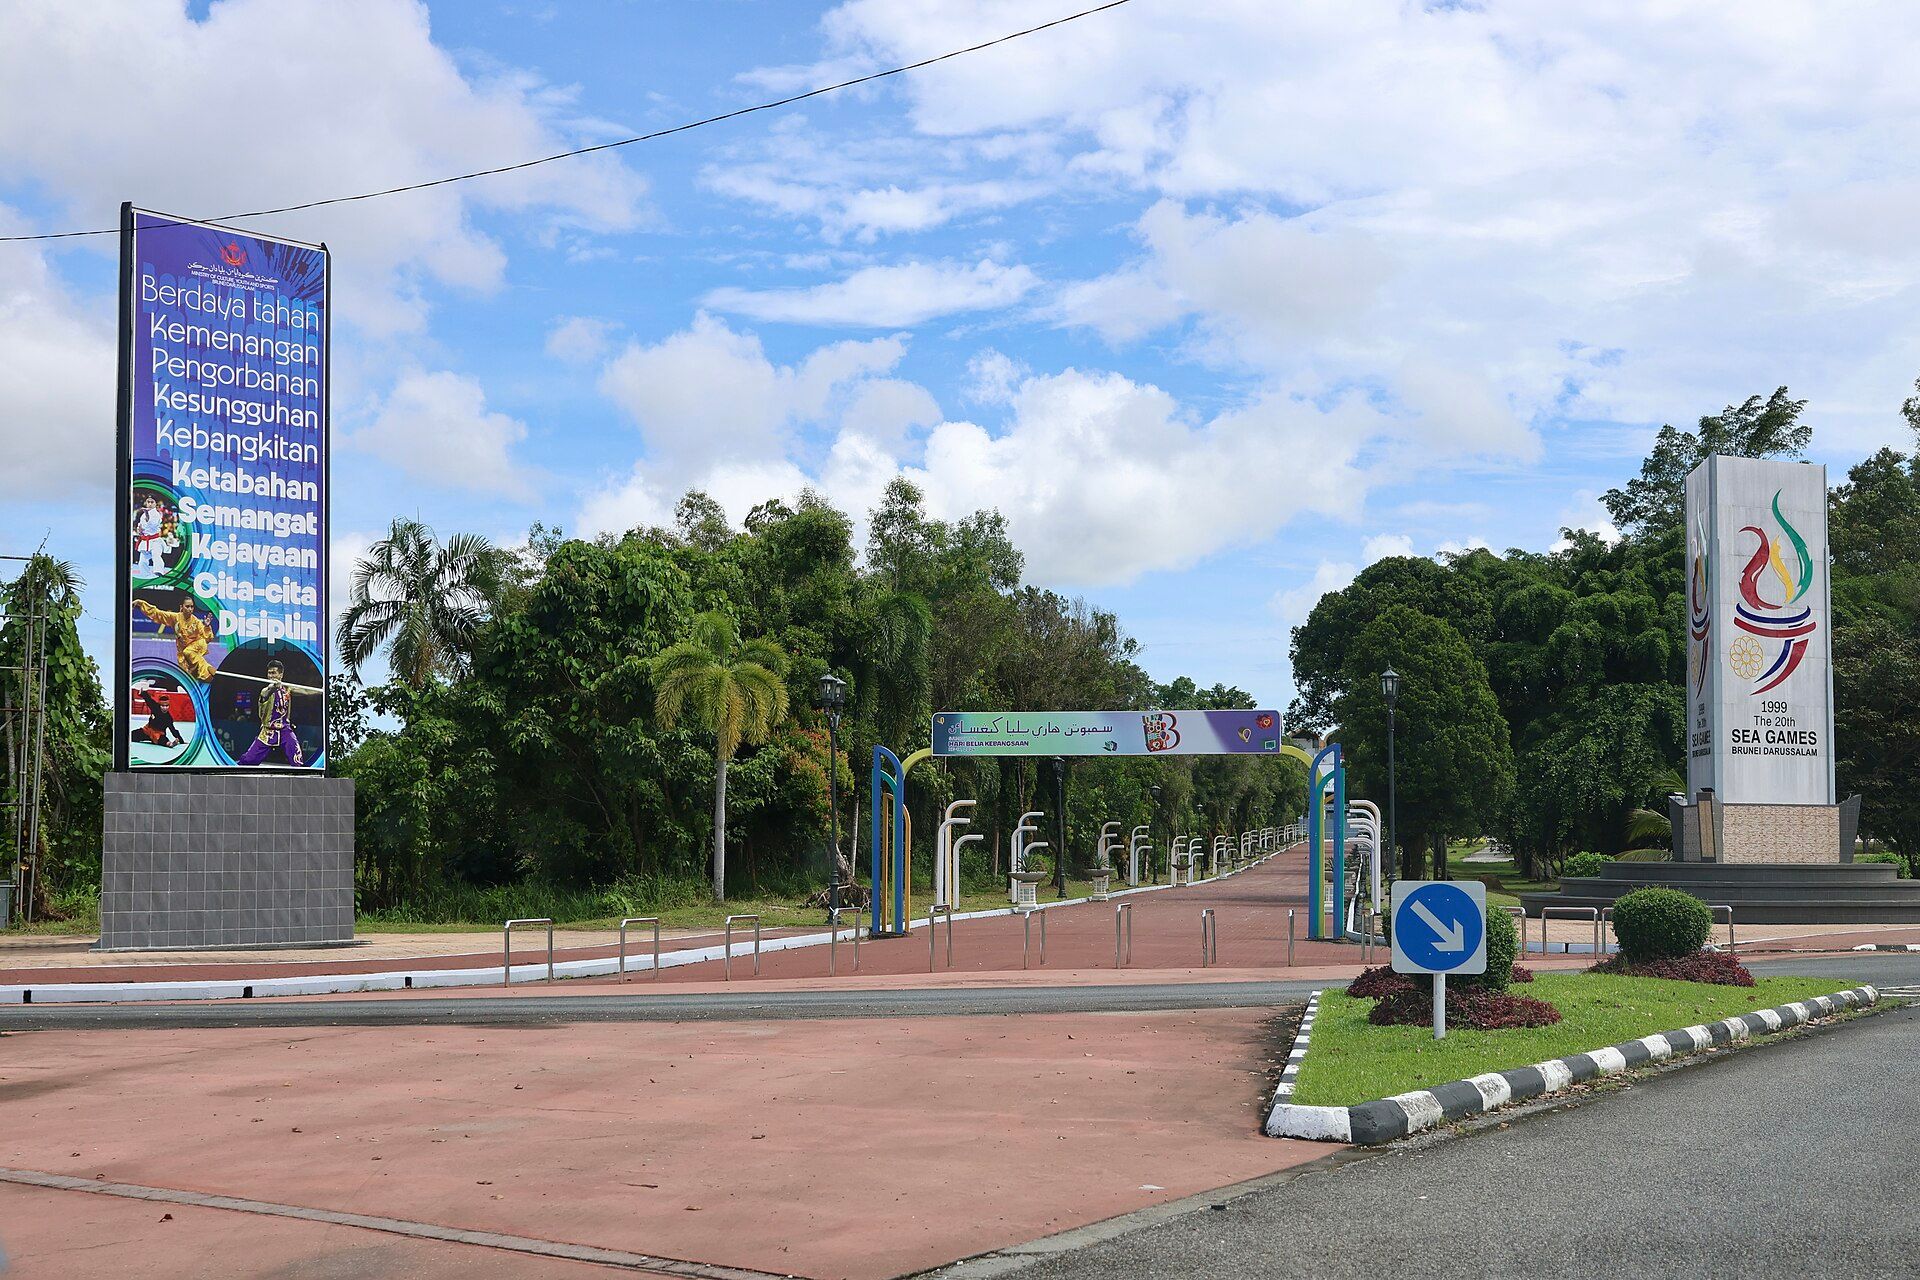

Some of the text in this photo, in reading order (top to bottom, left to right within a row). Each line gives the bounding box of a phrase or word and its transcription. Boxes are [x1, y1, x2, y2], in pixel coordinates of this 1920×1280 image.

[142, 274, 319, 331] Berdaya tahan
[151, 311, 319, 366] Kemenangan
[152, 347, 319, 398] Pengorbanan
[154, 381, 318, 429] Kesungguhan
[156, 417, 318, 464] Kebangkitan
[172, 460, 318, 502] Ketabahan
[178, 496, 318, 538] Semangat
[191, 532, 317, 570] Kejayaan
[193, 571, 317, 607] Cita-cita
[219, 609, 317, 643] Disiplin
[1753, 715, 1796, 727] The 20th
[1761, 700, 1788, 713] 1999
[1031, 721, 1060, 739] هاري
[1731, 728, 1817, 745] SEA GAMES
[1731, 746, 1818, 756] BRUNEI DARUSSALAM
